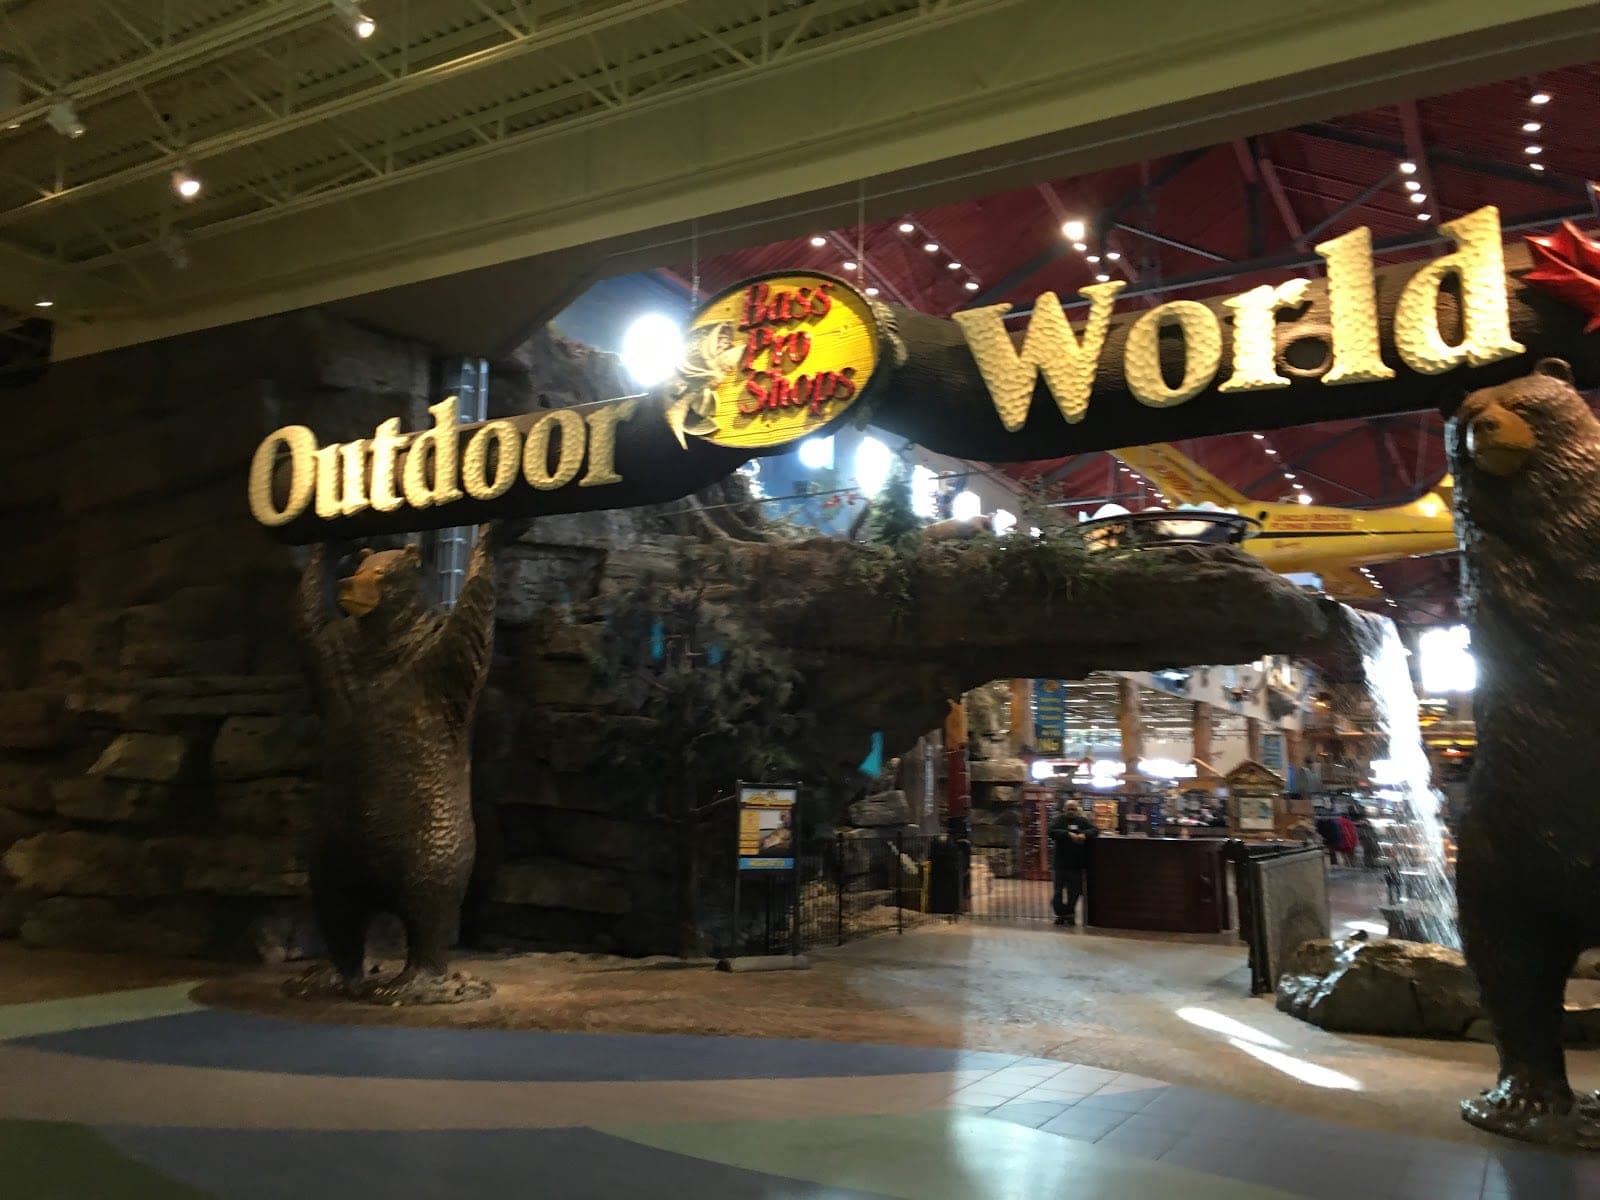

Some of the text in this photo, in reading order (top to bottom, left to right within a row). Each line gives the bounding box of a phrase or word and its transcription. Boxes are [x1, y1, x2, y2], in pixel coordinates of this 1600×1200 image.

[740, 282, 834, 330] Bass
[249, 205, 1526, 527] Outdoor World
[744, 327, 812, 371] Pro
[739, 367, 856, 416] Shops
